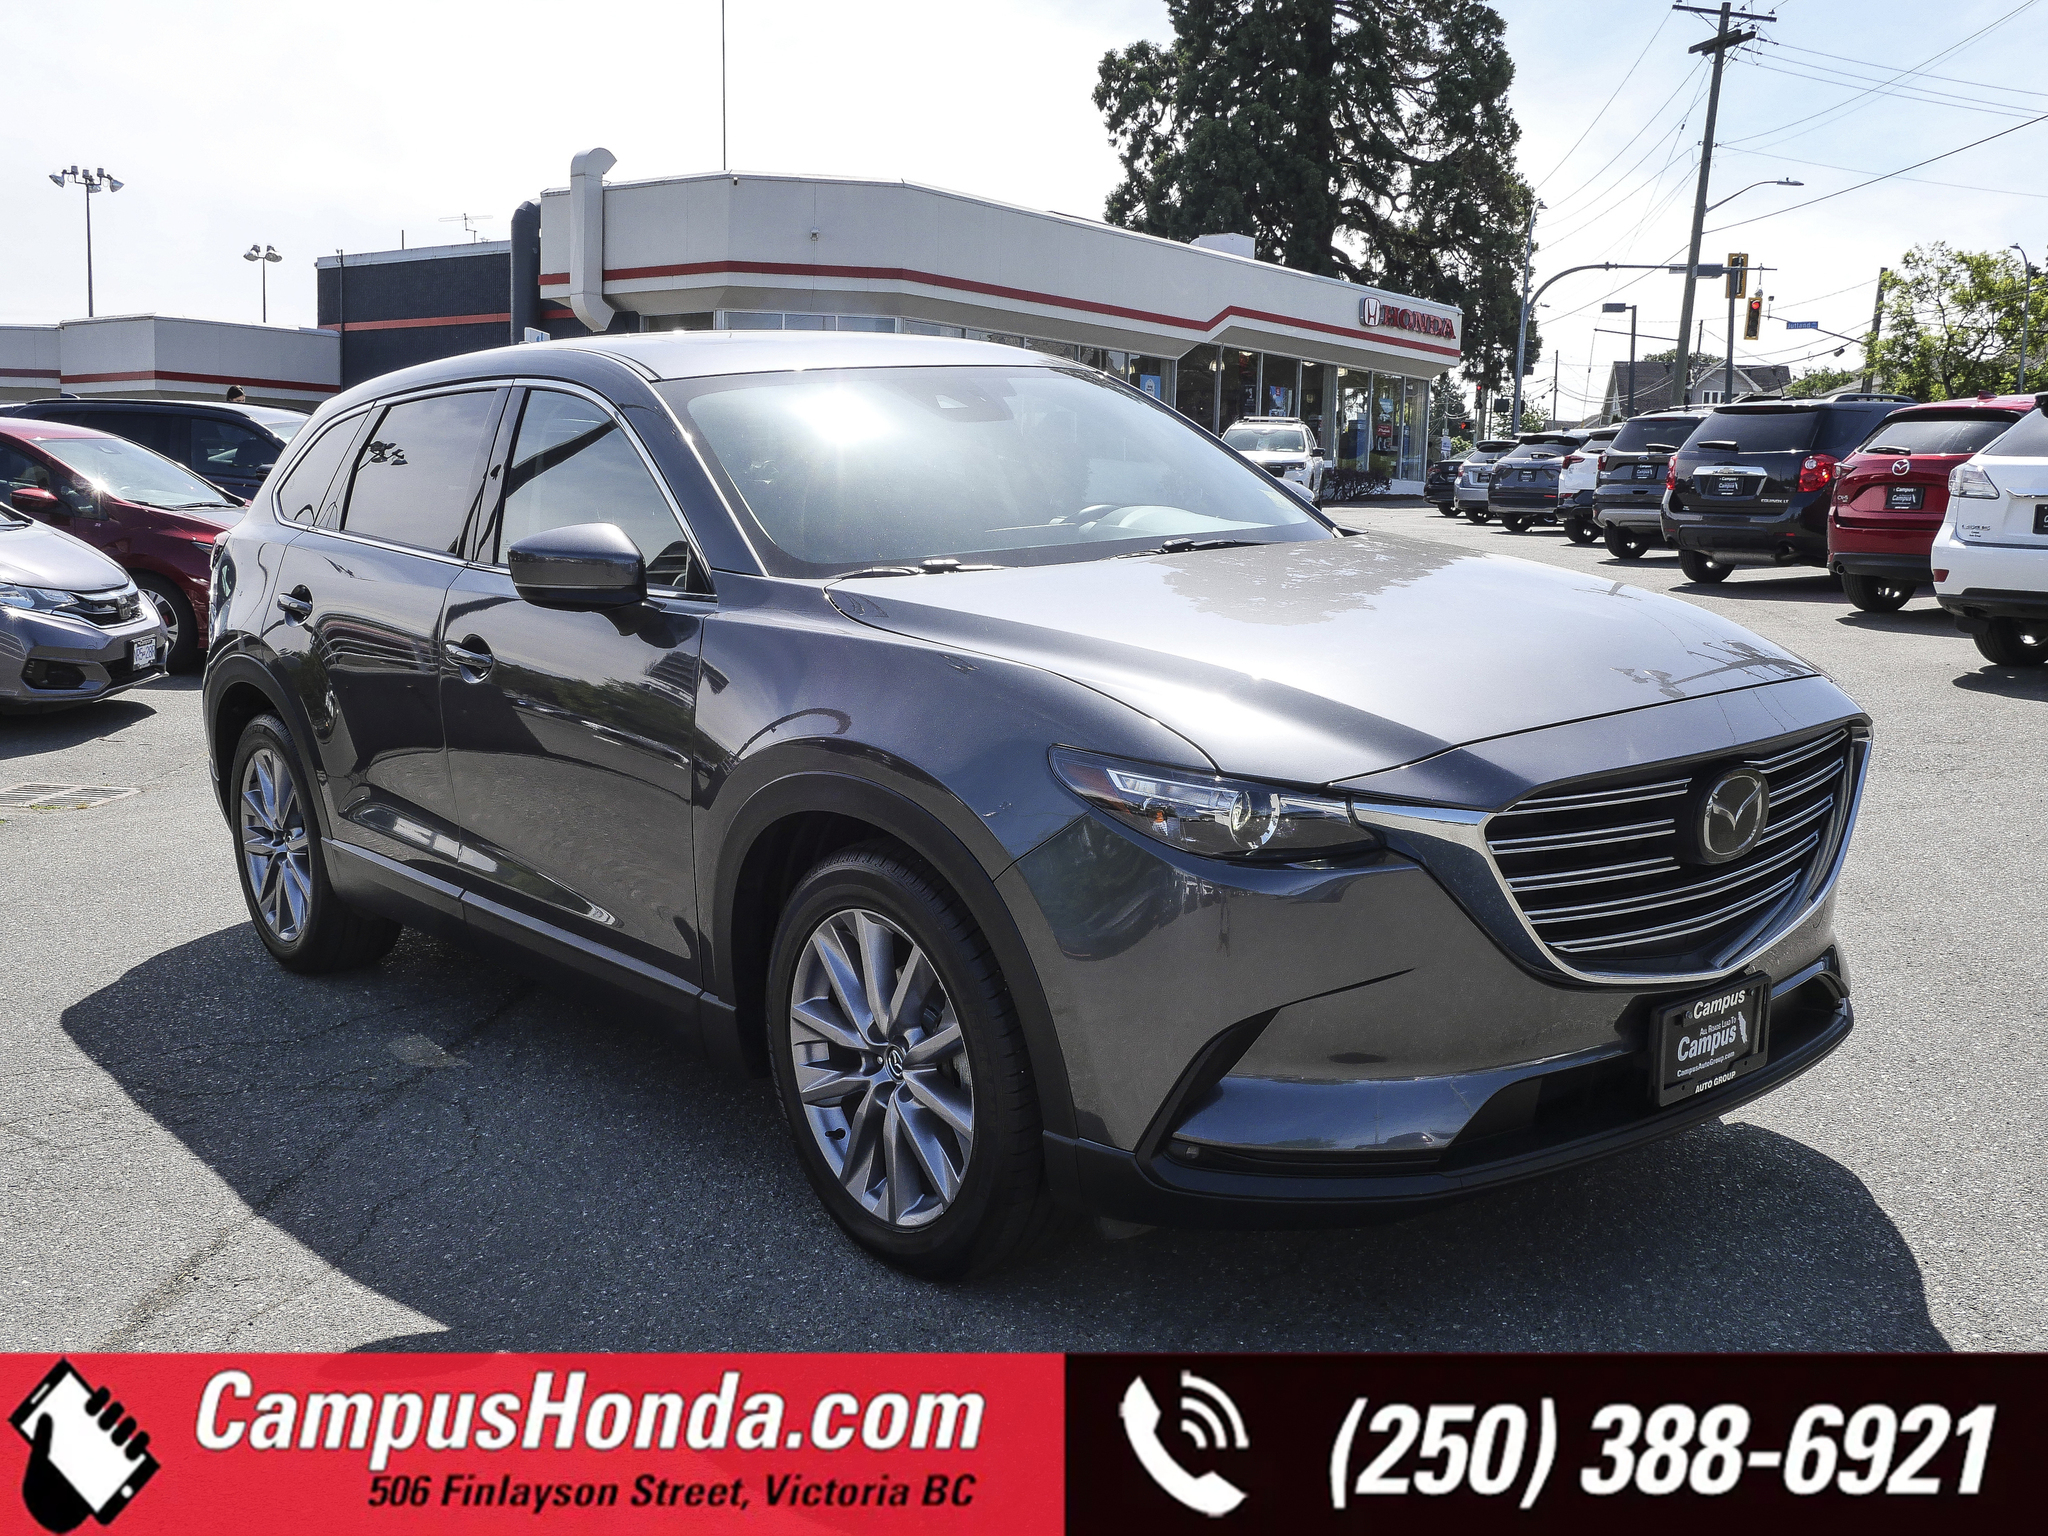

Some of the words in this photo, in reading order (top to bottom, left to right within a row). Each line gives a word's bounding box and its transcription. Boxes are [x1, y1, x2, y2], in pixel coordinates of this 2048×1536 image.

[1382, 305, 1456, 339] HONDA
[1693, 990, 1746, 1019] Campus
[1677, 1025, 1737, 1062] Campus
[1677, 1051, 1735, 1077] CampusAutoGroup.com
[1694, 1079, 1713, 1094] AUTO
[1713, 1070, 1736, 1086] GROUP
